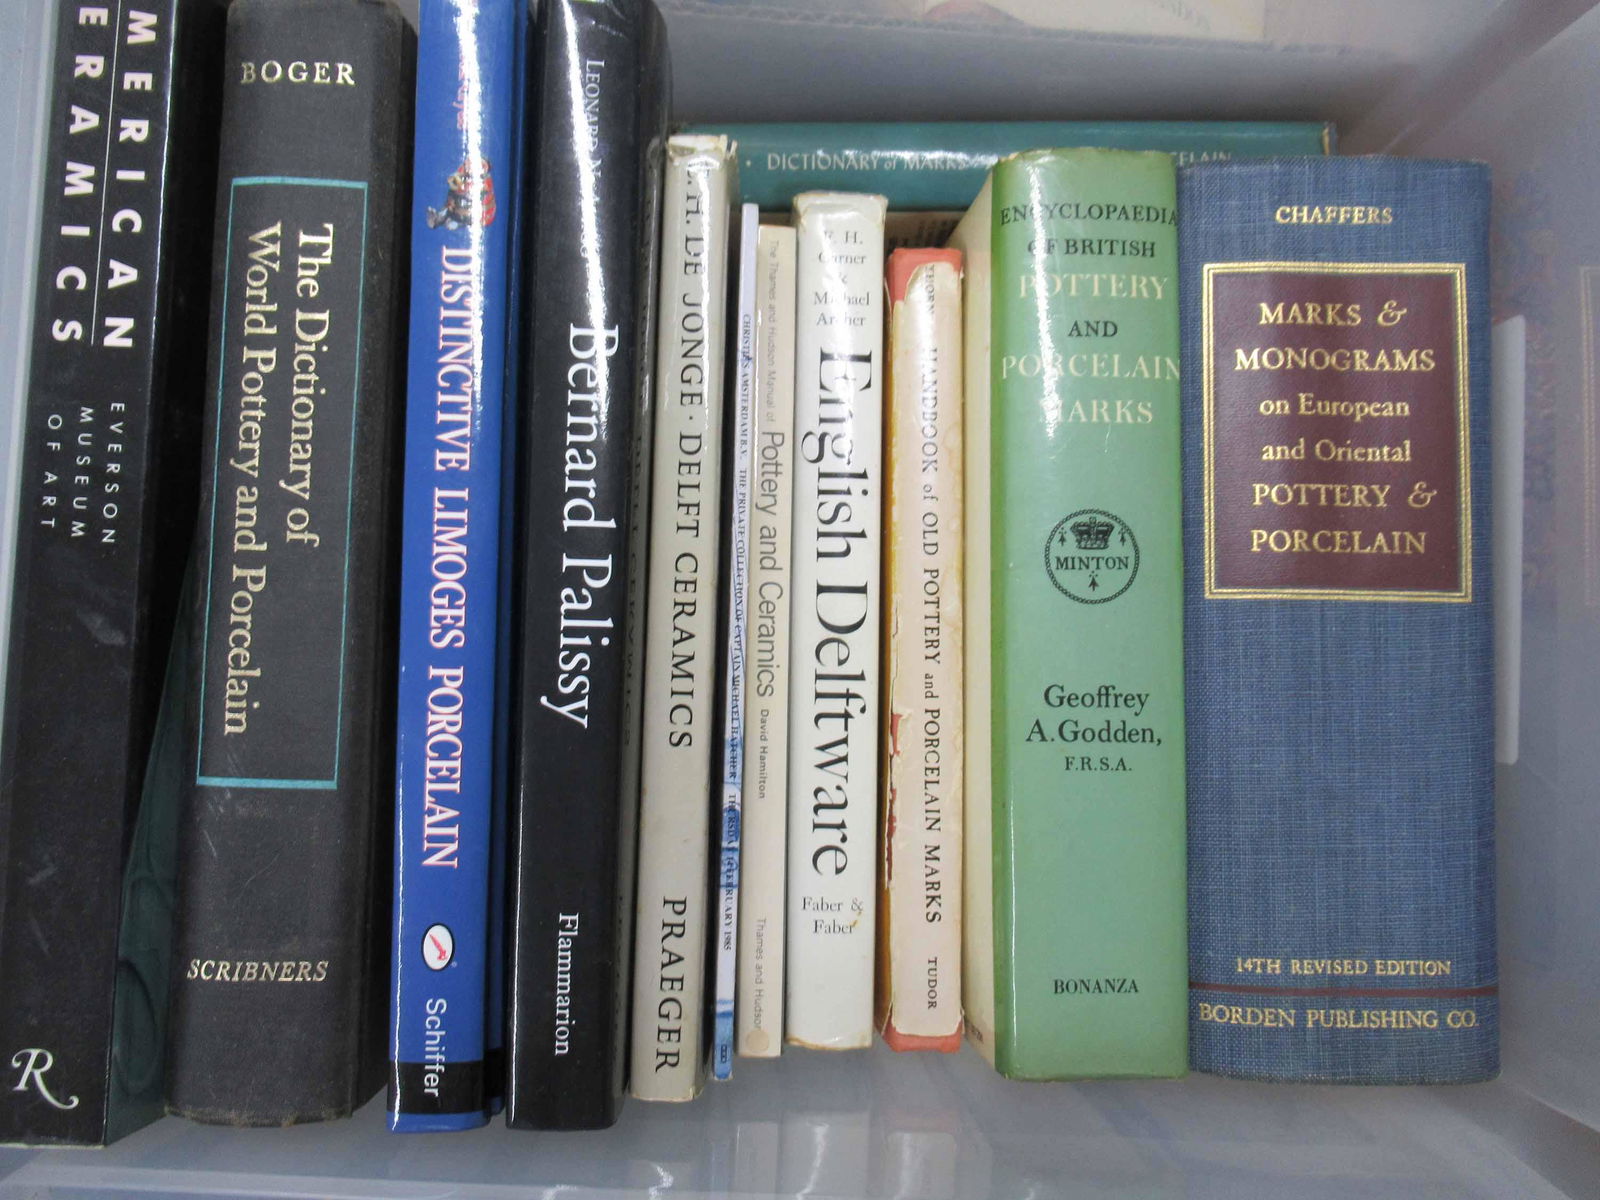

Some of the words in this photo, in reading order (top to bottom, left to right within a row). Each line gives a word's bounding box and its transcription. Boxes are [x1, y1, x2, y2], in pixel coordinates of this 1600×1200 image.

[240, 61, 356, 86] BOGER
[52, 7, 108, 342] ERAMICS
[103, 10, 158, 348] MERICAN
[767, 152, 878, 171] DICTIONARY
[884, 153, 897, 171] of
[1000, 202, 1178, 226] ENYCLOPAEDIA
[1275, 205, 1393, 225] CHAFFERS
[295, 223, 334, 299] The
[684, 234, 707, 276] DE
[1065, 238, 1156, 258] BRITISH
[244, 220, 282, 337] World
[814, 291, 870, 306] Mhael
[1019, 273, 1168, 300] POTTERY
[816, 312, 866, 326] Arher
[1068, 320, 1118, 337] AND
[1259, 302, 1361, 326] MARKS
[1376, 300, 1407, 326] &
[434, 246, 475, 472] DISTINCTIVE
[680, 293, 706, 406] JONGE
[1002, 352, 1180, 380] PORCELAIN
[1234, 347, 1435, 371] MONOGRAMS
[230, 347, 277, 479] Pottery
[279, 309, 330, 501] Dictionary
[562, 322, 619, 532] Bernard
[739, 371, 751, 437] AMSTERDAM
[921, 347, 938, 473] HANDBOOK
[1259, 398, 1291, 416] on
[1298, 392, 1411, 423] European
[47, 414, 62, 451] OF
[802, 347, 872, 563] English
[1261, 438, 1305, 461] and
[1315, 439, 1411, 463] Oriental
[70, 407, 94, 538] MUSEUM
[102, 402, 125, 543] EVERSON
[676, 433, 701, 537] DELFT
[755, 431, 785, 517] Pottery
[922, 484, 938, 500] of
[1252, 483, 1391, 507] POTTERY
[1407, 481, 1438, 508] &
[40, 473, 57, 529] ART
[232, 487, 268, 554] and
[285, 510, 321, 549] of
[760, 526, 784, 571] and
[922, 512, 939, 556] OLD
[1250, 529, 1426, 554] PORCELAIN
[429, 487, 469, 649] LIMOGES
[1055, 556, 1130, 571] MINTON
[757, 581, 784, 697] Ceramics
[923, 568, 941, 665] POTTERY
[223, 560, 267, 737] Porcelain
[540, 553, 614, 730] Palissy
[669, 551, 698, 748] CERAMICS
[924, 673, 940, 699] and
[1044, 684, 1150, 717] Geoffrey
[760, 709, 770, 742] David
[811, 581, 868, 876] Delftware
[422, 665, 464, 868] PORCELAIN
[758, 745, 768, 799] Hamilton
[924, 708, 941, 832] PORCELAIN
[802, 897, 843, 912] Faber
[851, 897, 863, 912] &
[925, 844, 942, 923] MARKS
[756, 917, 767, 960] Thames
[813, 920, 855, 934] Faber
[187, 959, 329, 982] SCRIBNERS
[554, 912, 579, 1056] Flammarion
[655, 896, 687, 1072] PRAEGER
[755, 964, 765, 985] and
[927, 956, 938, 1010] TUDOR
[1053, 978, 1139, 995] BONANZA
[1236, 957, 1281, 975] 14TH
[1290, 958, 1368, 976] REVISED
[1375, 959, 1451, 976] EDITION
[1199, 1003, 1296, 1027] BORDEN
[1306, 1008, 1438, 1029] PUBLISHING
[424, 997, 447, 1097] Schiffer
[11, 1048, 79, 1110] R
